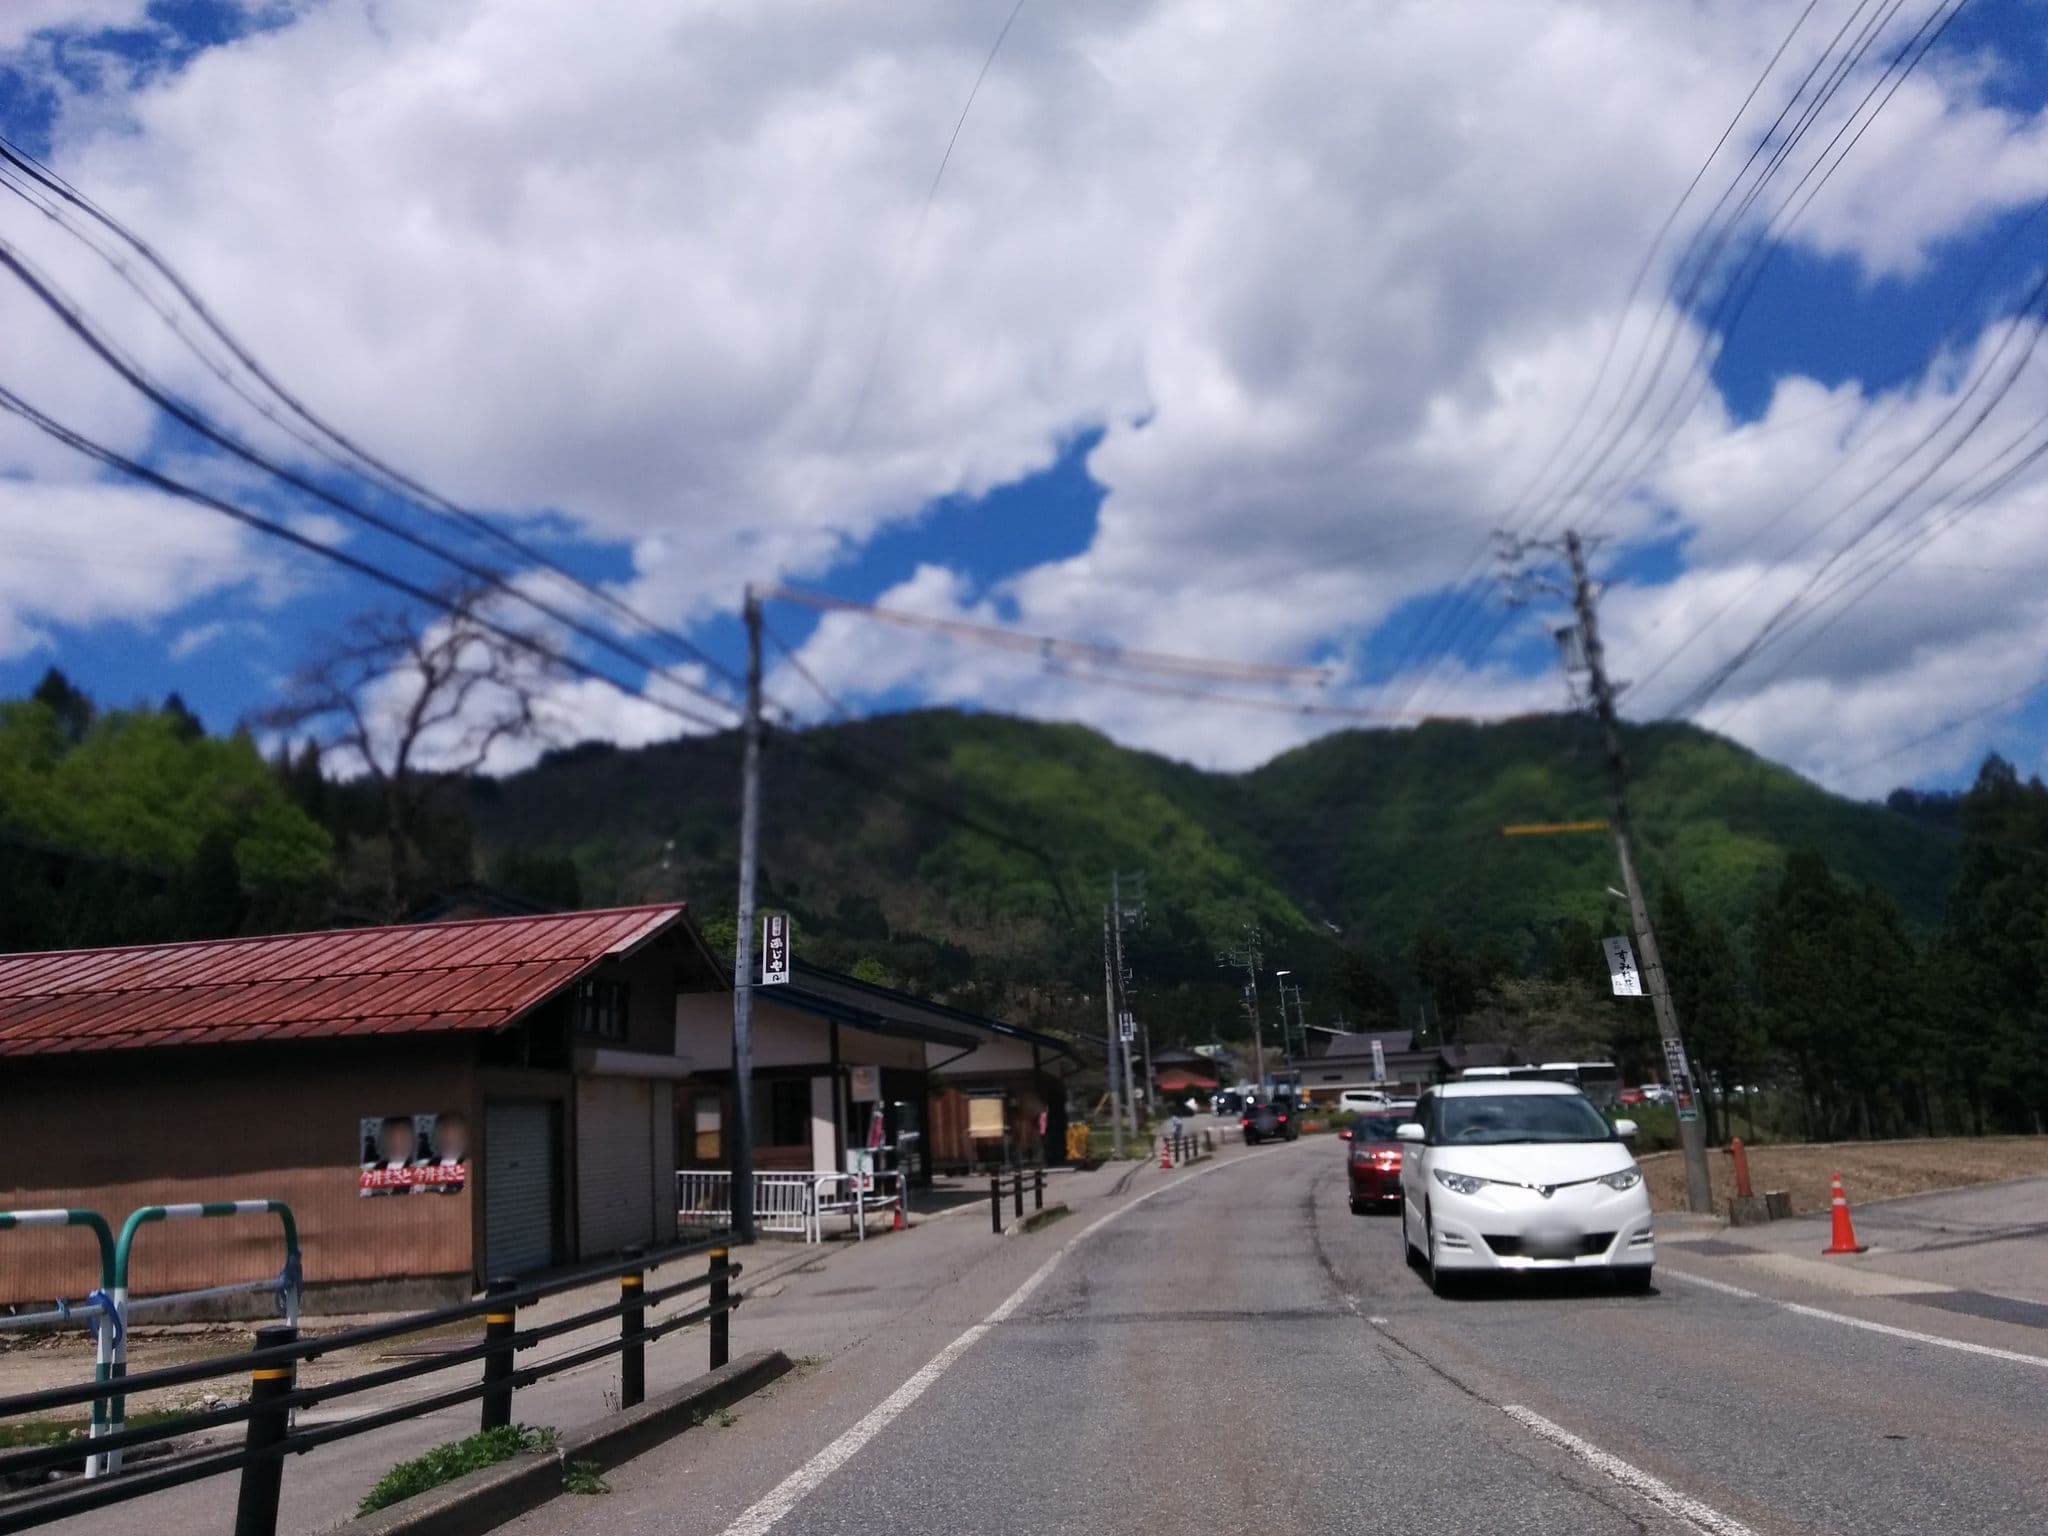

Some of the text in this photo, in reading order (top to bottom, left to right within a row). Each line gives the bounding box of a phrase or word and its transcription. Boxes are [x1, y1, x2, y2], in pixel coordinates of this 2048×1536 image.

[360, 1168, 412, 1186] 今井まさと
[415, 1164, 465, 1182] 今井まさと
